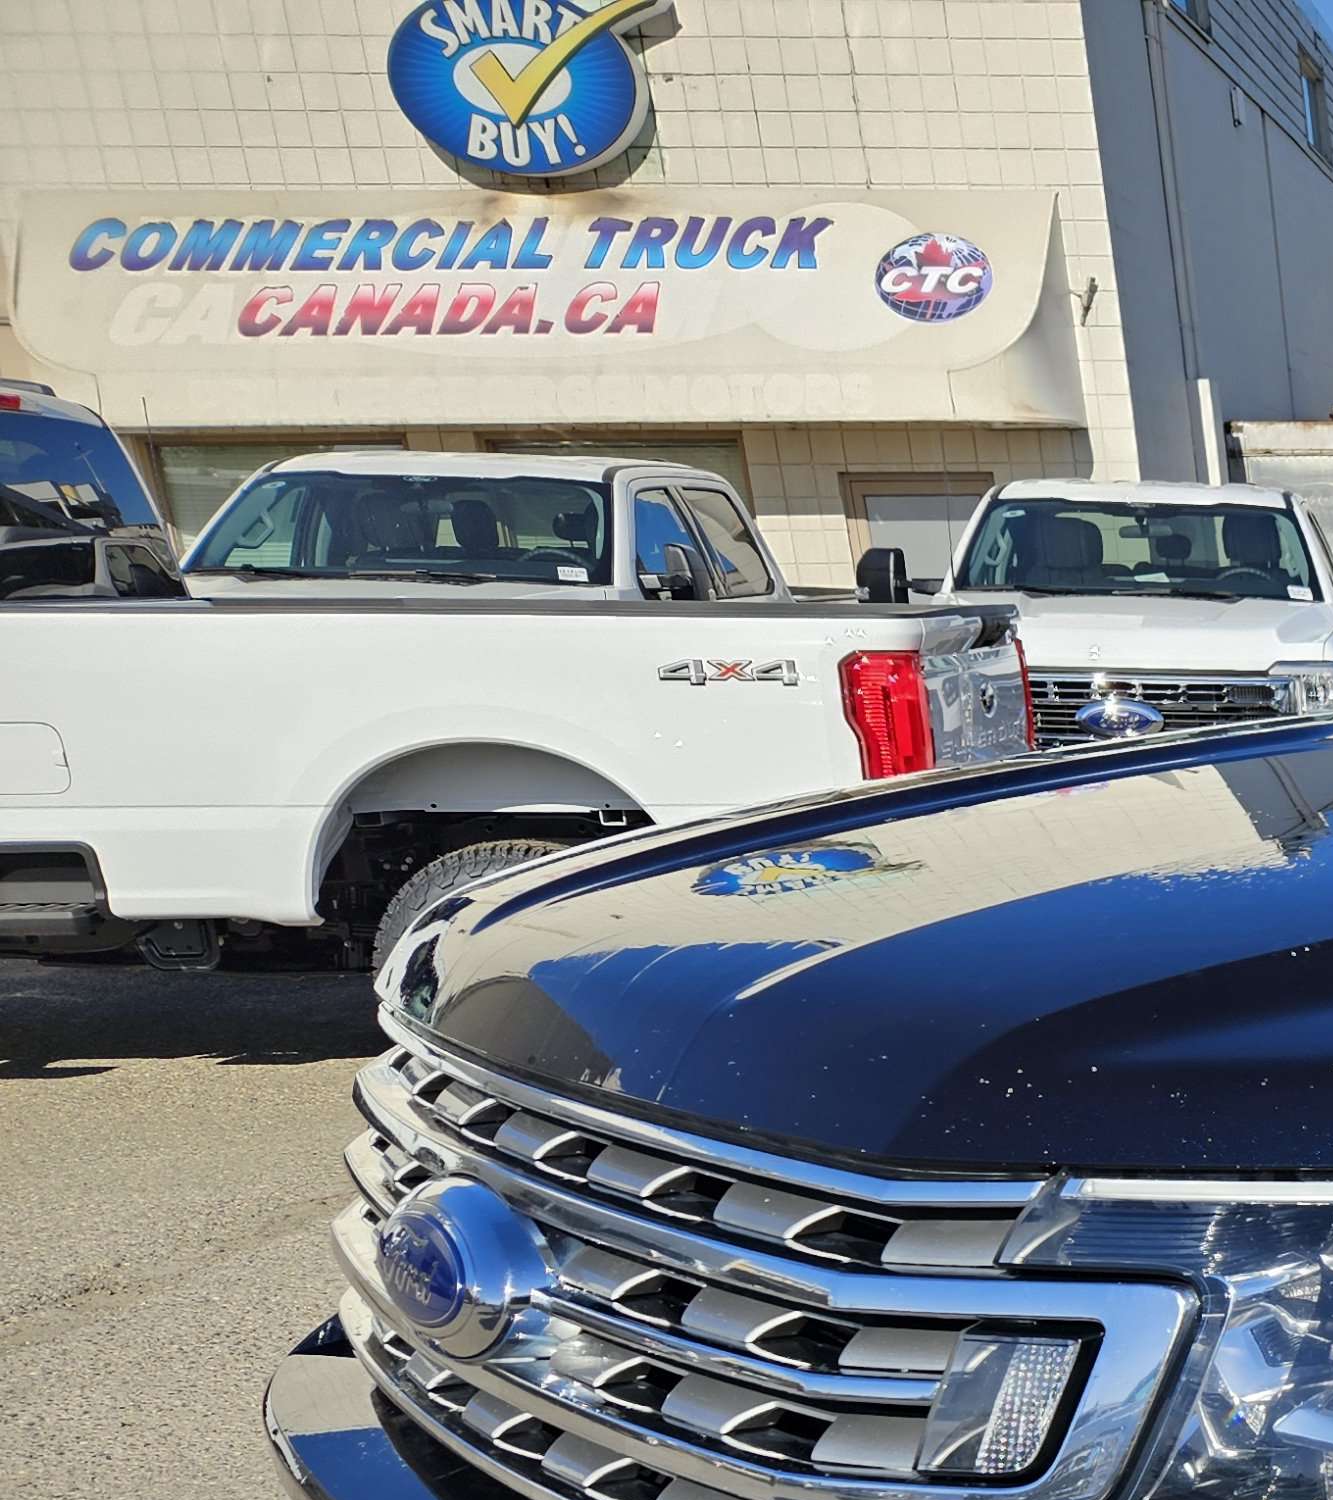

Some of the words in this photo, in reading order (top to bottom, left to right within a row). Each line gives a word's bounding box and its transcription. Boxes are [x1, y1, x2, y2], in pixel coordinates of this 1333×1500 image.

[420, 0, 582, 57] SMART
[467, 113, 586, 167] BUY!
[69, 217, 553, 272] COMMERCIAL
[584, 216, 834, 269] TRUCK
[881, 266, 986, 294] CTC
[238, 281, 660, 337] CANADA.CA
